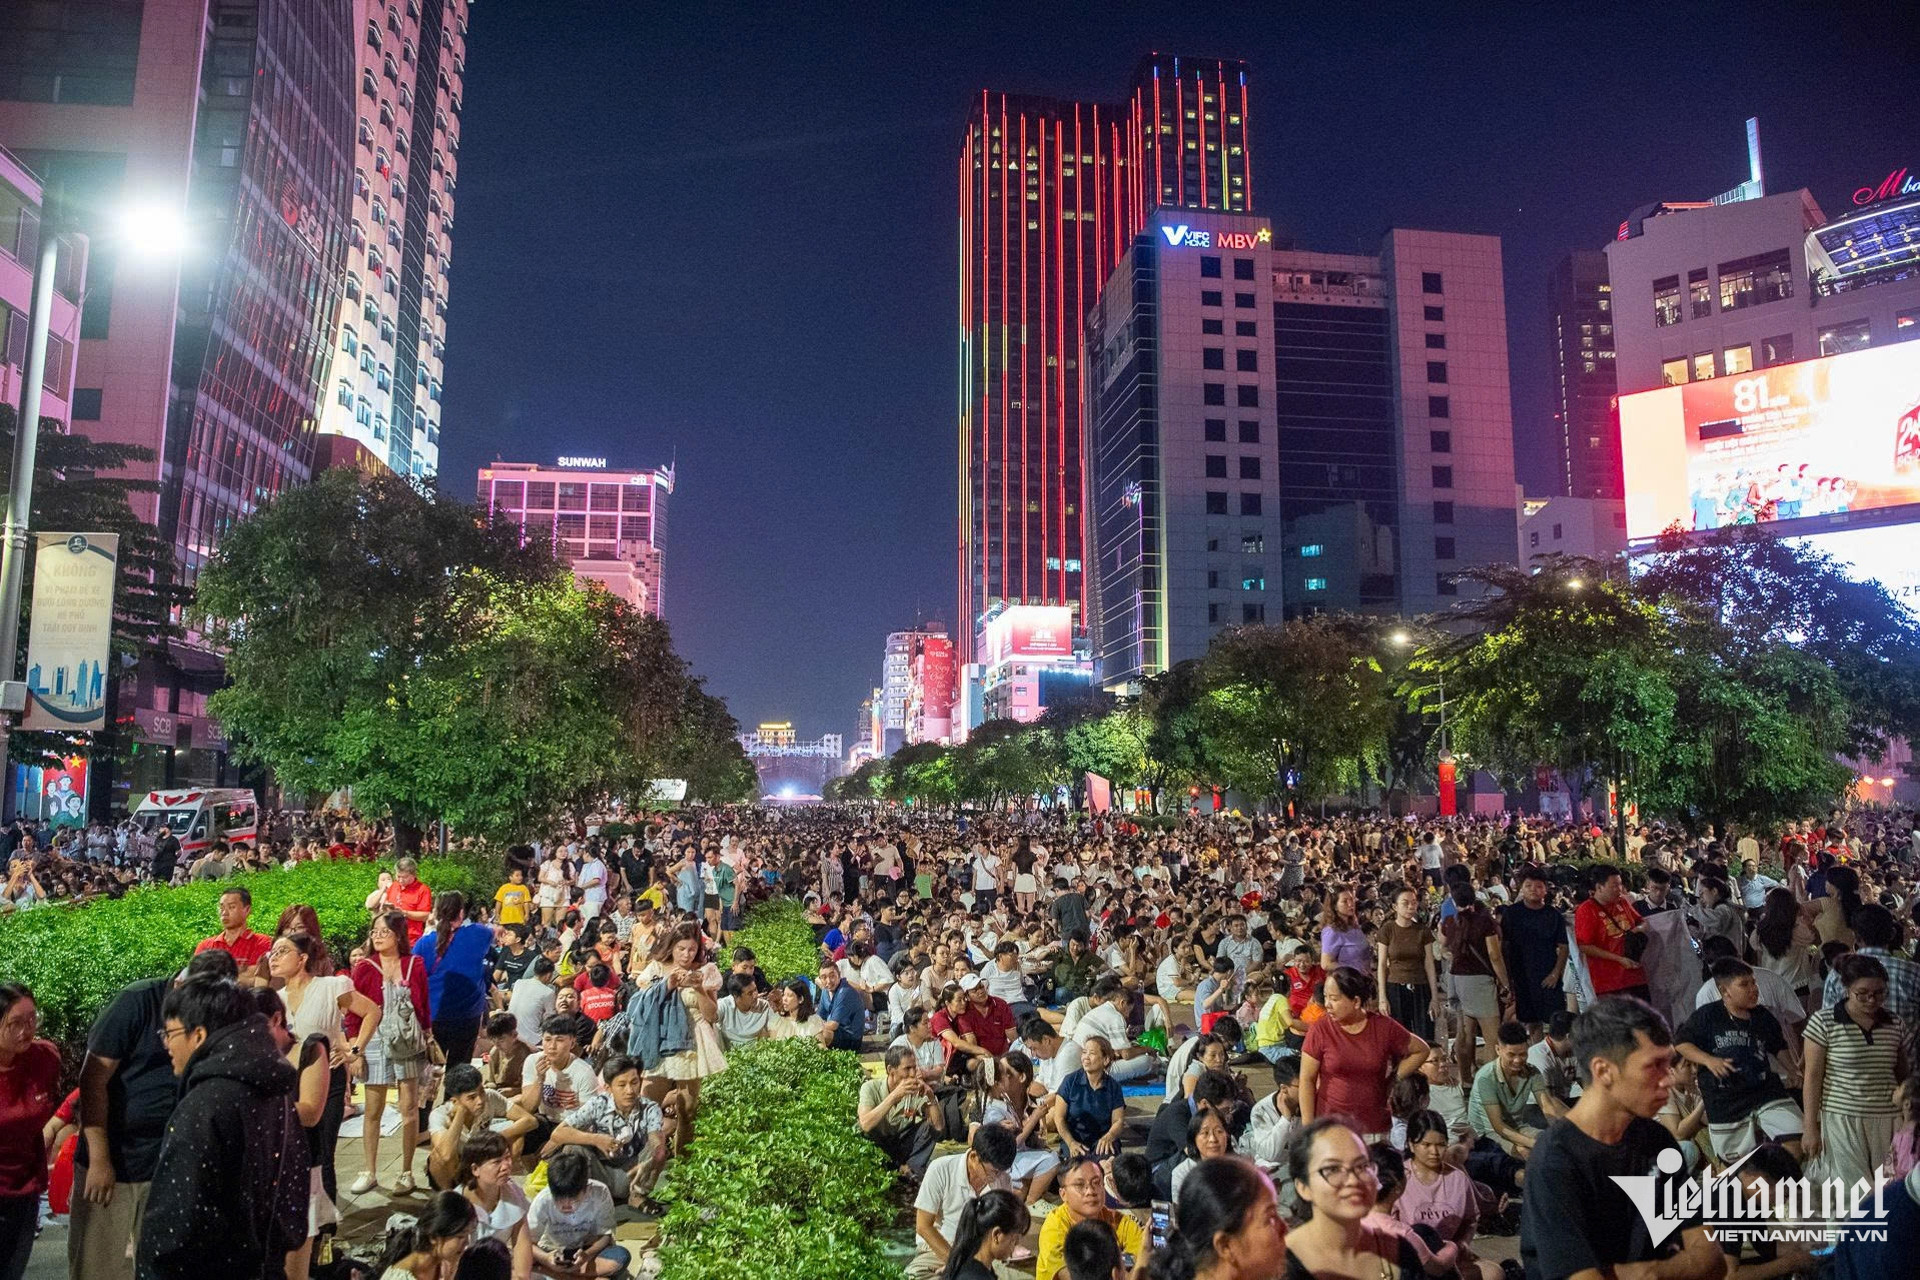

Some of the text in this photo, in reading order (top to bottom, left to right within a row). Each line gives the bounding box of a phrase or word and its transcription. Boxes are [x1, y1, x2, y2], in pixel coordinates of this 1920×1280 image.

[1185, 231, 1210, 241] VIFC
[1217, 232, 1259, 250] MBV
[1184, 239, 1210, 248] HCMC
[557, 456, 607, 468] SUNWAH
[53, 562, 97, 577] KHÔNG
[153, 715, 172, 735] SCB
